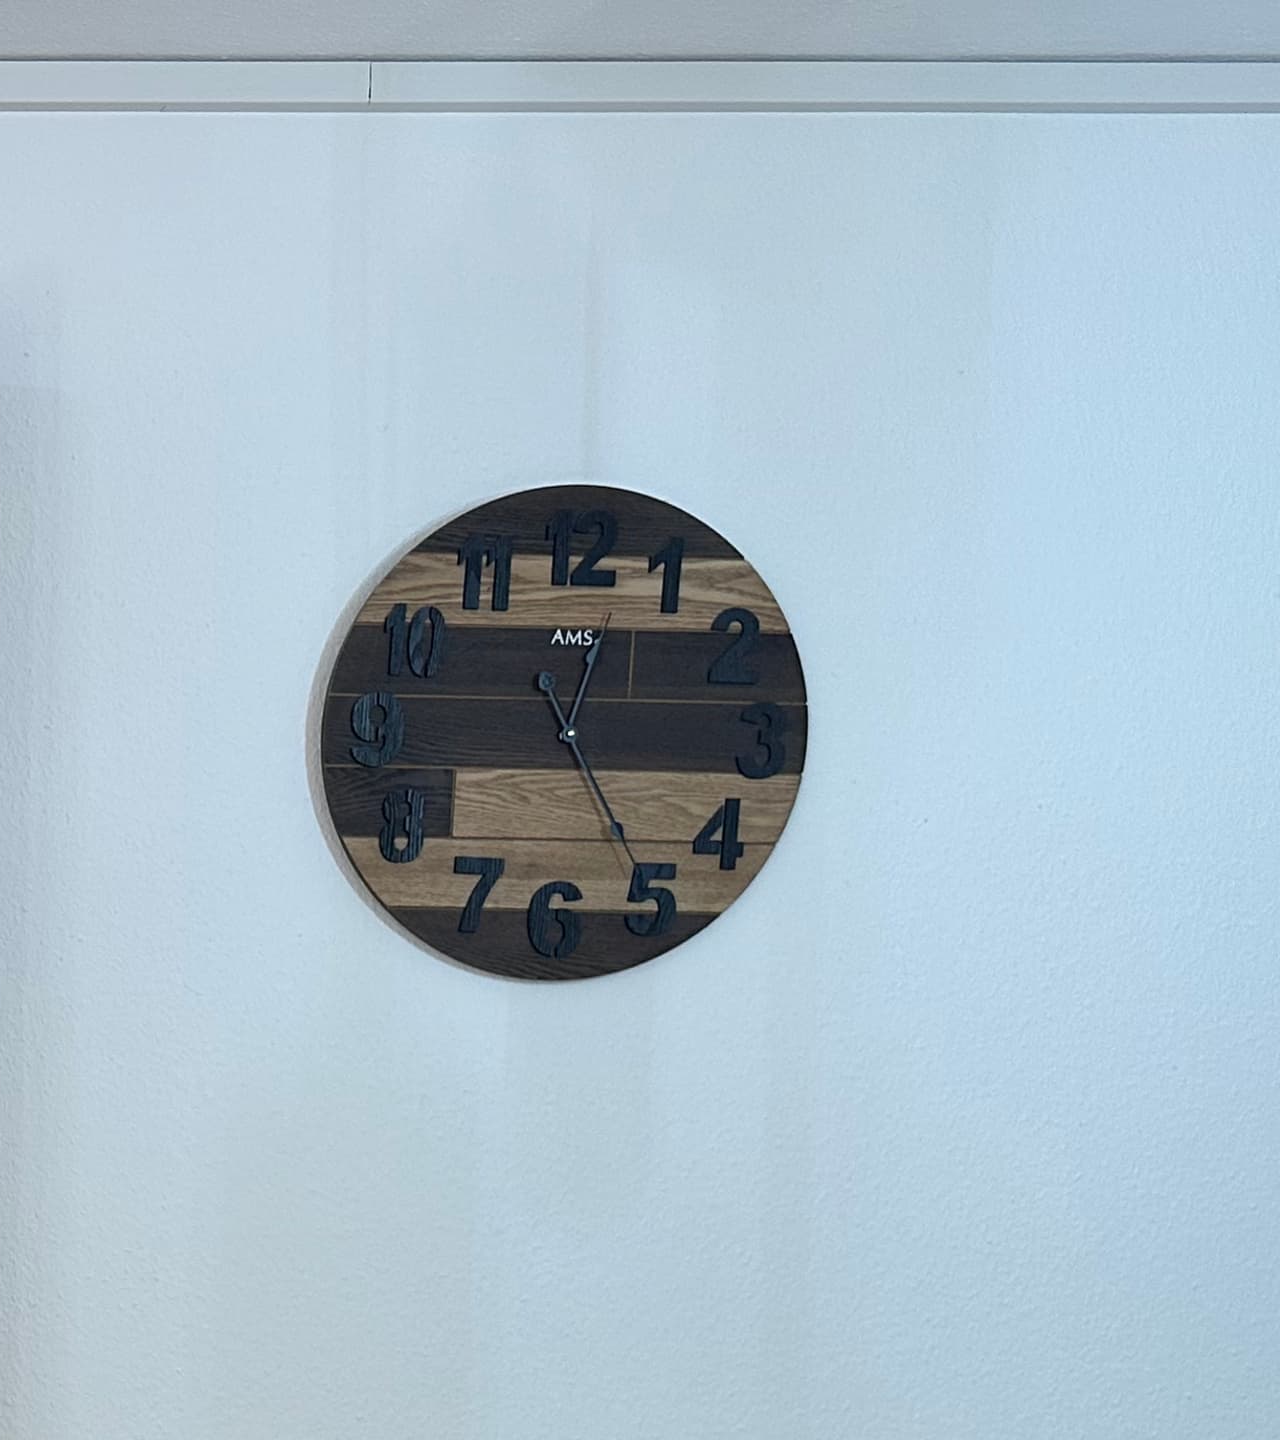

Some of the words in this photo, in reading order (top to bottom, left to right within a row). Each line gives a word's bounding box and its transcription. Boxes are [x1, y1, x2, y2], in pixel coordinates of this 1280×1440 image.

[457, 535, 513, 611] 11
[545, 510, 618, 587] 12
[648, 537, 685, 613] 1
[383, 603, 446, 679] 10
[550, 629, 593, 646] AMS
[707, 607, 760, 684] 2
[350, 691, 405, 767] 9
[735, 702, 790, 779] 3
[379, 789, 424, 863] 8
[692, 798, 744, 870] 4
[453, 856, 505, 933] 7
[527, 881, 583, 959] 6
[624, 863, 677, 936] 5
